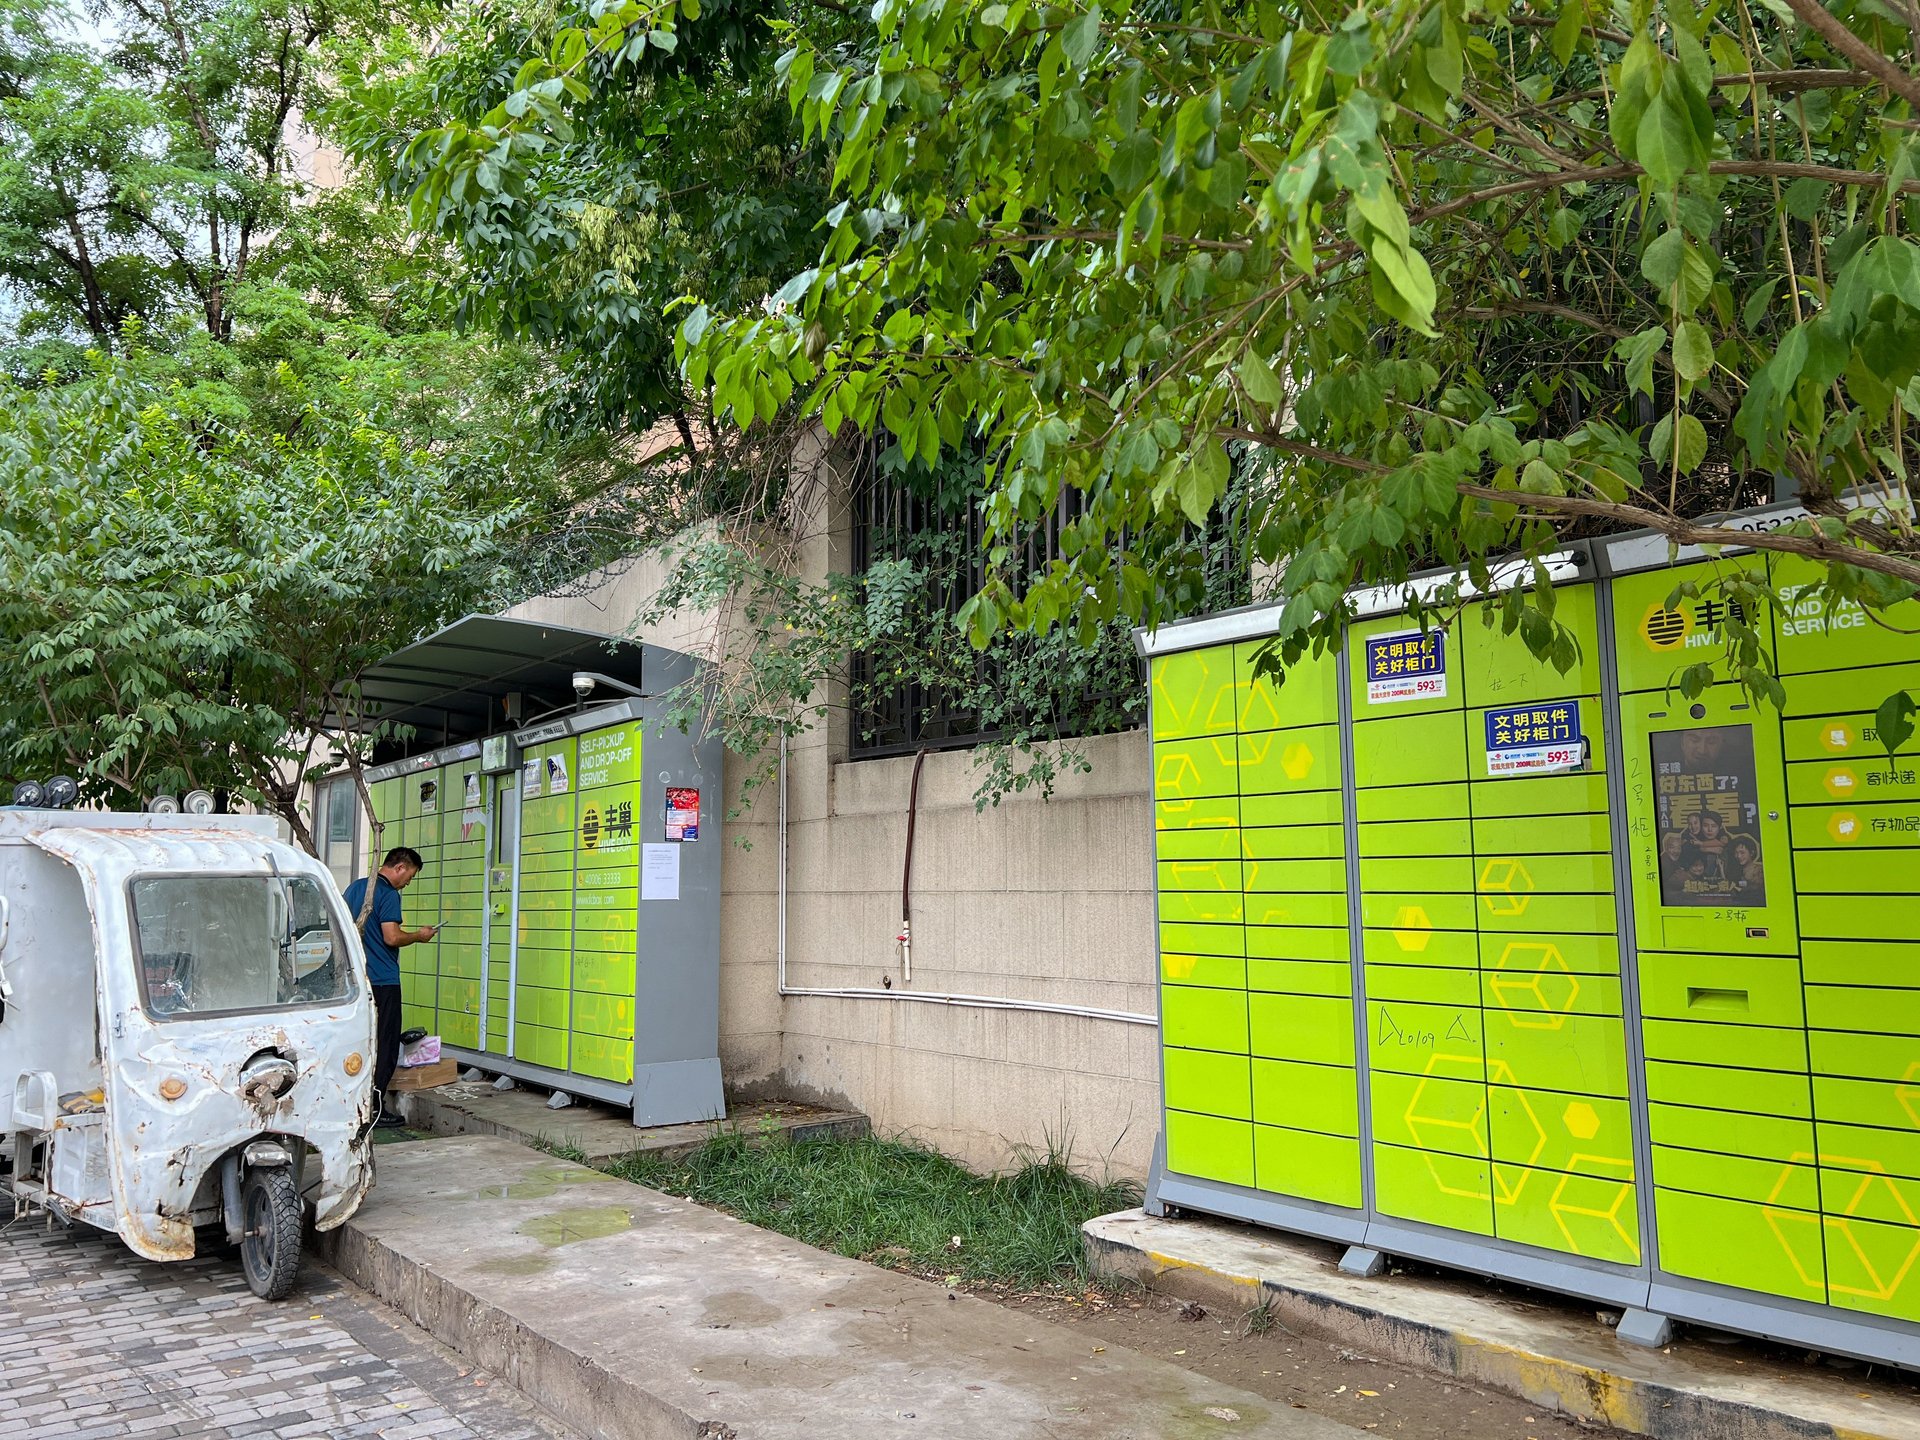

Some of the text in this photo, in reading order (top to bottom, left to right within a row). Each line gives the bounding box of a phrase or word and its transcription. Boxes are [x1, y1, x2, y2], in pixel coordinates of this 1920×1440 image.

[1782, 600, 1822, 620] AND
[1782, 611, 1867, 637] SERVICE
[1374, 640, 1436, 660] 文明取件
[1685, 632, 1724, 648] HIV
[1375, 655, 1436, 675] 关好柜门
[1417, 680, 1435, 691] 593
[1494, 708, 1569, 729] 文明取件
[580, 731, 625, 754] SELF-PICKUP
[1495, 724, 1570, 745] 关好柜门
[580, 747, 632, 770] AND DROP-OFF
[1547, 750, 1569, 763] 593
[580, 769, 608, 787] SERVICE
[1866, 770, 1916, 786] 寄快递
[604, 801, 632, 839] 丰巢
[1871, 816, 1920, 832] 存物品
